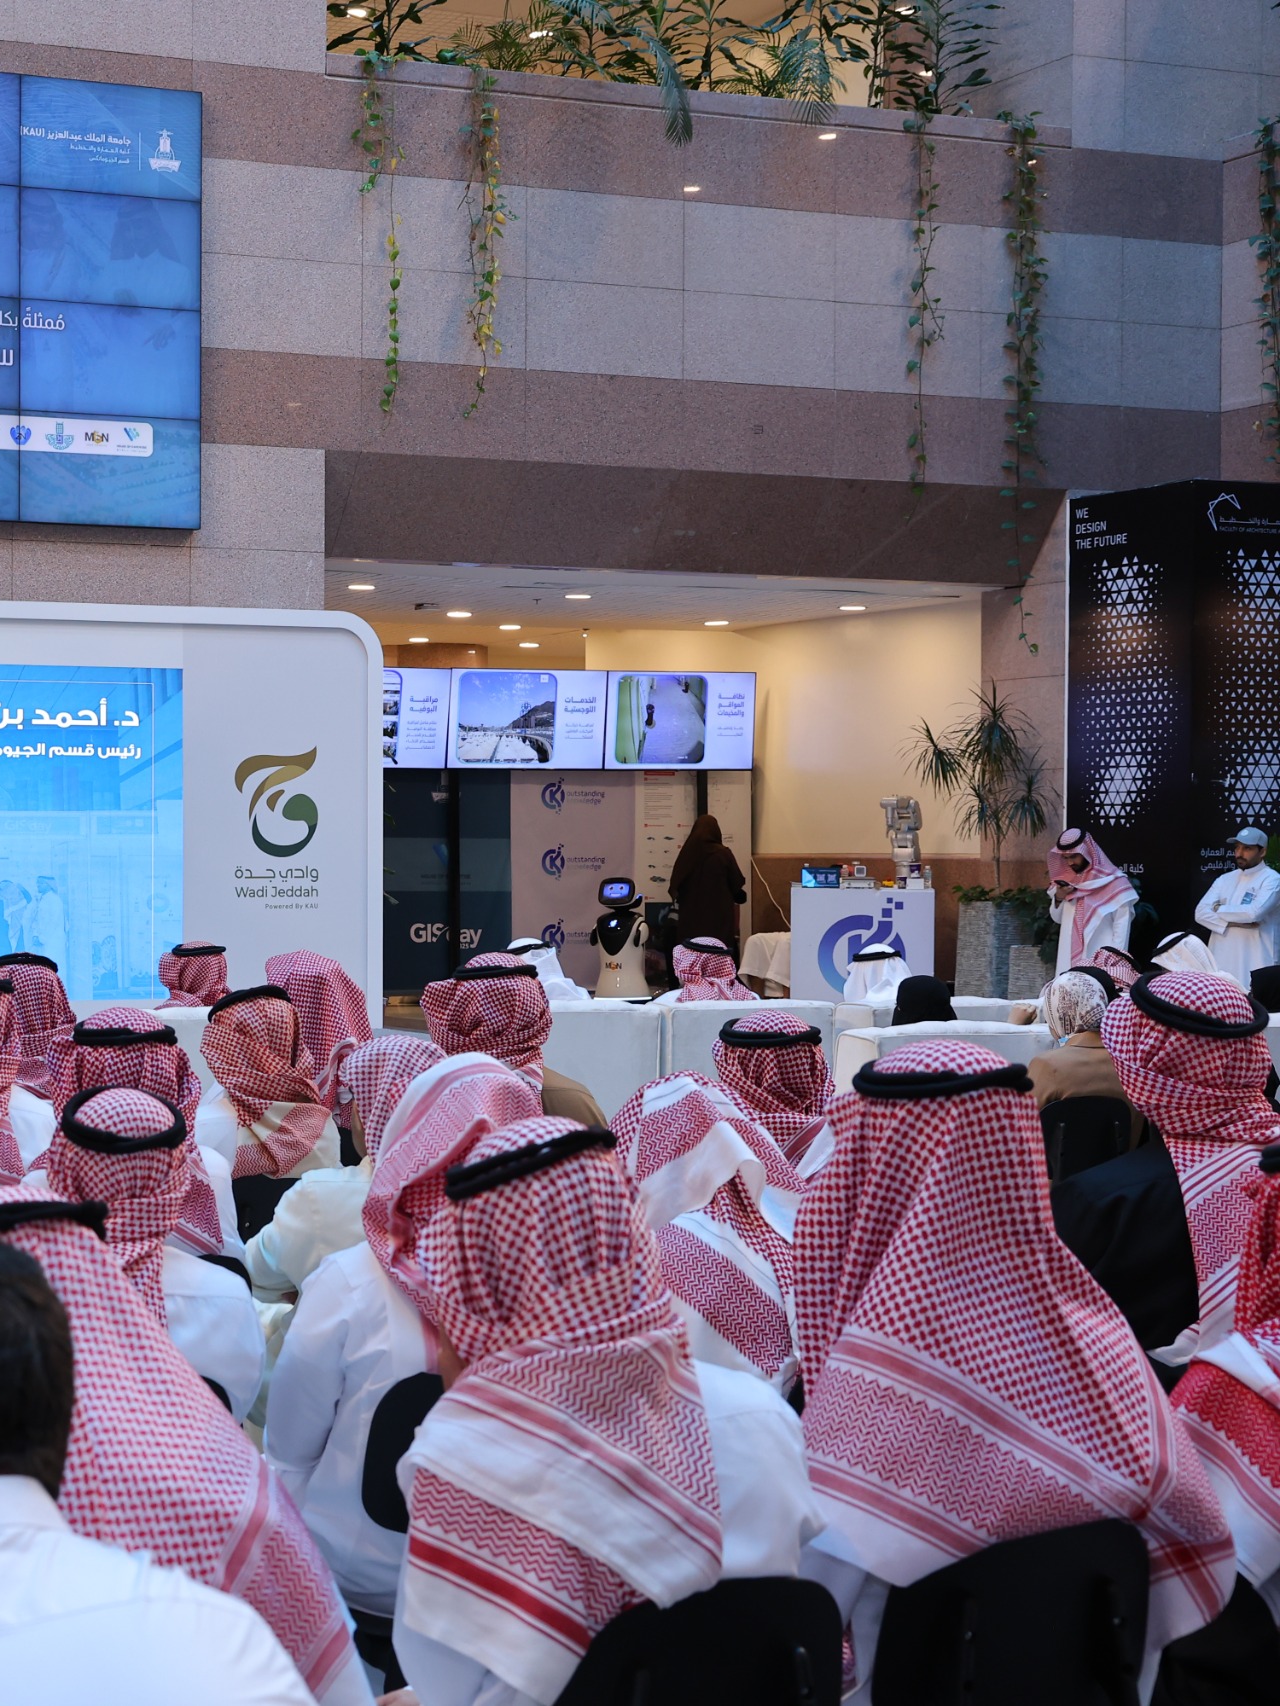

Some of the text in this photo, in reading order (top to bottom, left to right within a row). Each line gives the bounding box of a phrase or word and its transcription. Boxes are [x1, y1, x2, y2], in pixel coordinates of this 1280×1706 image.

[47, 130, 82, 142] عبدالعزيز
[84, 132, 106, 144] الملك
[108, 135, 132, 147] جامعة
[1076, 508, 1089, 520] WE
[1076, 520, 1107, 535] DESIGN
[1076, 533, 1128, 550] THE FUTURE
[564, 696, 597, 704] الخدمات
[31, 697, 108, 728] أحمد
[113, 710, 140, 727] د.
[48, 743, 95, 758] قسم
[97, 744, 142, 760] رئيس
[566, 790, 605, 798] outstanding
[1200, 848, 1224, 858] العمارة
[234, 865, 319, 883] وادي جدة
[1128, 864, 1144, 874] كلية
[234, 886, 319, 898] Wadi Jeddah
